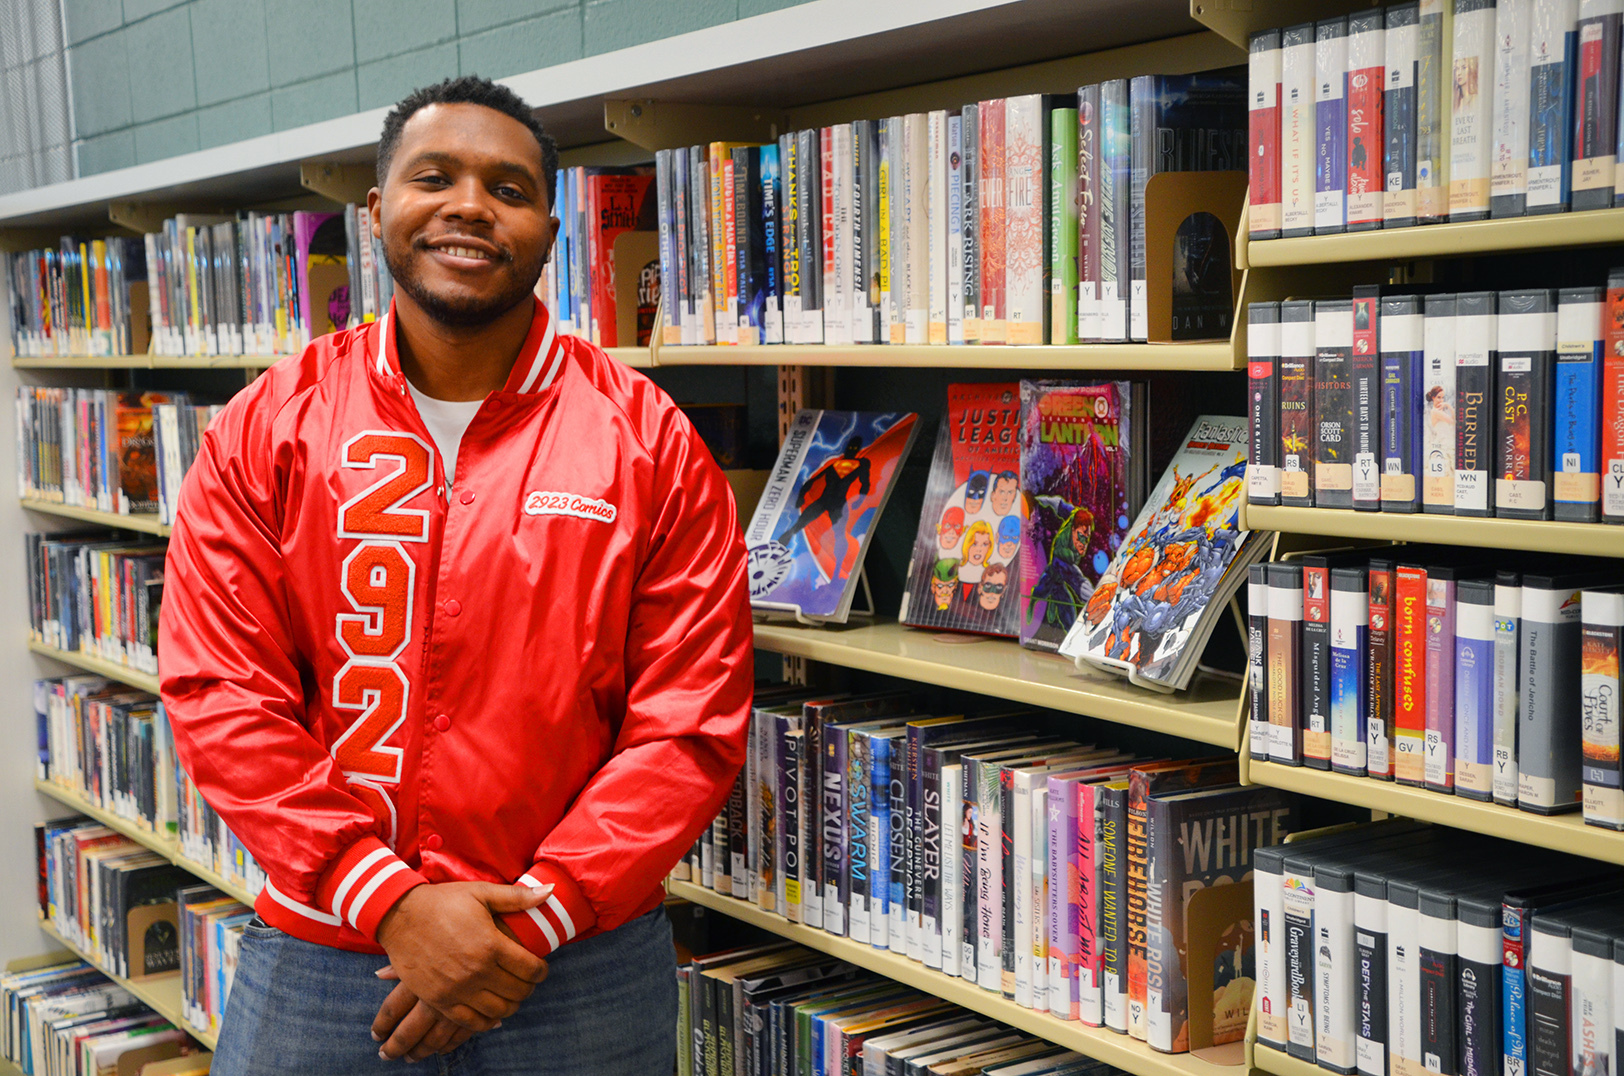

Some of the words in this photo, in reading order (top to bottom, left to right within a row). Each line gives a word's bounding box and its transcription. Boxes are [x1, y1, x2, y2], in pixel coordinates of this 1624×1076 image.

[1292, 109, 1300, 142] WHAT
[1455, 115, 1475, 125] EVERY
[1456, 126, 1472, 136] LAST
[1052, 142, 1062, 170] Ask
[1292, 149, 1300, 159] IF
[1321, 144, 1326, 156] NO
[1452, 135, 1477, 146] BREATH
[1078, 128, 1092, 186] Select
[788, 144, 798, 220] THANKS
[822, 151, 832, 197] BAD
[880, 169, 888, 200] GIRL
[1389, 176, 1400, 186] KE
[712, 176, 721, 208] HOLD
[734, 166, 747, 244] TIMEBOUND
[764, 178, 775, 217] TIME'S
[951, 175, 960, 224] PIECING
[1009, 177, 1032, 206] FIRE
[1292, 189, 1300, 204] US
[1079, 189, 1093, 228] Few
[660, 222, 669, 268] OTHER
[766, 222, 775, 253] EDGE
[781, 206, 791, 283] STRANGE
[1052, 216, 1062, 262] Green
[678, 224, 687, 295] PROSPECT
[880, 238, 888, 269] BAD
[964, 236, 973, 296] RISING
[1039, 396, 1096, 418] GREEN
[1282, 402, 1306, 410] RUINS
[1360, 378, 1368, 405] THIRTEEN
[1505, 386, 1514, 424] CAST
[1360, 406, 1368, 422] DAYS
[1041, 422, 1118, 446] LANTERN
[1191, 421, 1248, 444] Fantastic
[1320, 434, 1342, 442] CARD
[775, 430, 806, 483] SUPERMAN
[1360, 458, 1372, 468] RT
[1516, 454, 1524, 478] SUN
[1460, 474, 1477, 482] WN
[528, 496, 569, 509] 2923
[570, 499, 614, 519] Comics
[763, 486, 784, 511] ZERO
[750, 512, 772, 541] HOUR
[331, 430, 434, 800] 292
[1404, 596, 1417, 635] born
[1403, 640, 1417, 712] confused
[1529, 678, 1536, 686] of
[1528, 688, 1536, 721] Jericho
[1598, 684, 1612, 725] Court
[1398, 742, 1414, 752] GV
[1428, 734, 1438, 743] RS
[785, 740, 796, 820] PIVOT
[823, 771, 842, 860] NEXUS
[889, 779, 904, 873] CHOSEN
[944, 823, 954, 839] LET
[979, 822, 990, 836] If
[851, 784, 866, 880] SWARM
[924, 789, 940, 880] SLAYER
[944, 840, 954, 851] ME
[1104, 818, 1116, 877] SOMEONE
[1180, 807, 1290, 875] WHITE
[944, 852, 954, 870] LIST
[980, 840, 989, 862] I'm
[914, 836, 922, 900] GUINEVERE
[944, 872, 954, 885] THE
[944, 888, 954, 910] WAYS
[980, 868, 992, 901] Being
[1127, 818, 1148, 960] FIREHORSE
[1104, 890, 1117, 941] WANTED
[1147, 882, 1162, 945] WHITE
[1104, 947, 1118, 962] TO
[1362, 960, 1370, 990] DEFY
[1324, 1006, 1330, 1014] OF
[1362, 1002, 1370, 1038] STARS
[1510, 986, 1522, 1023] Palace
[1508, 1026, 1521, 1036] of
[1582, 1018, 1595, 1068] ASHES
